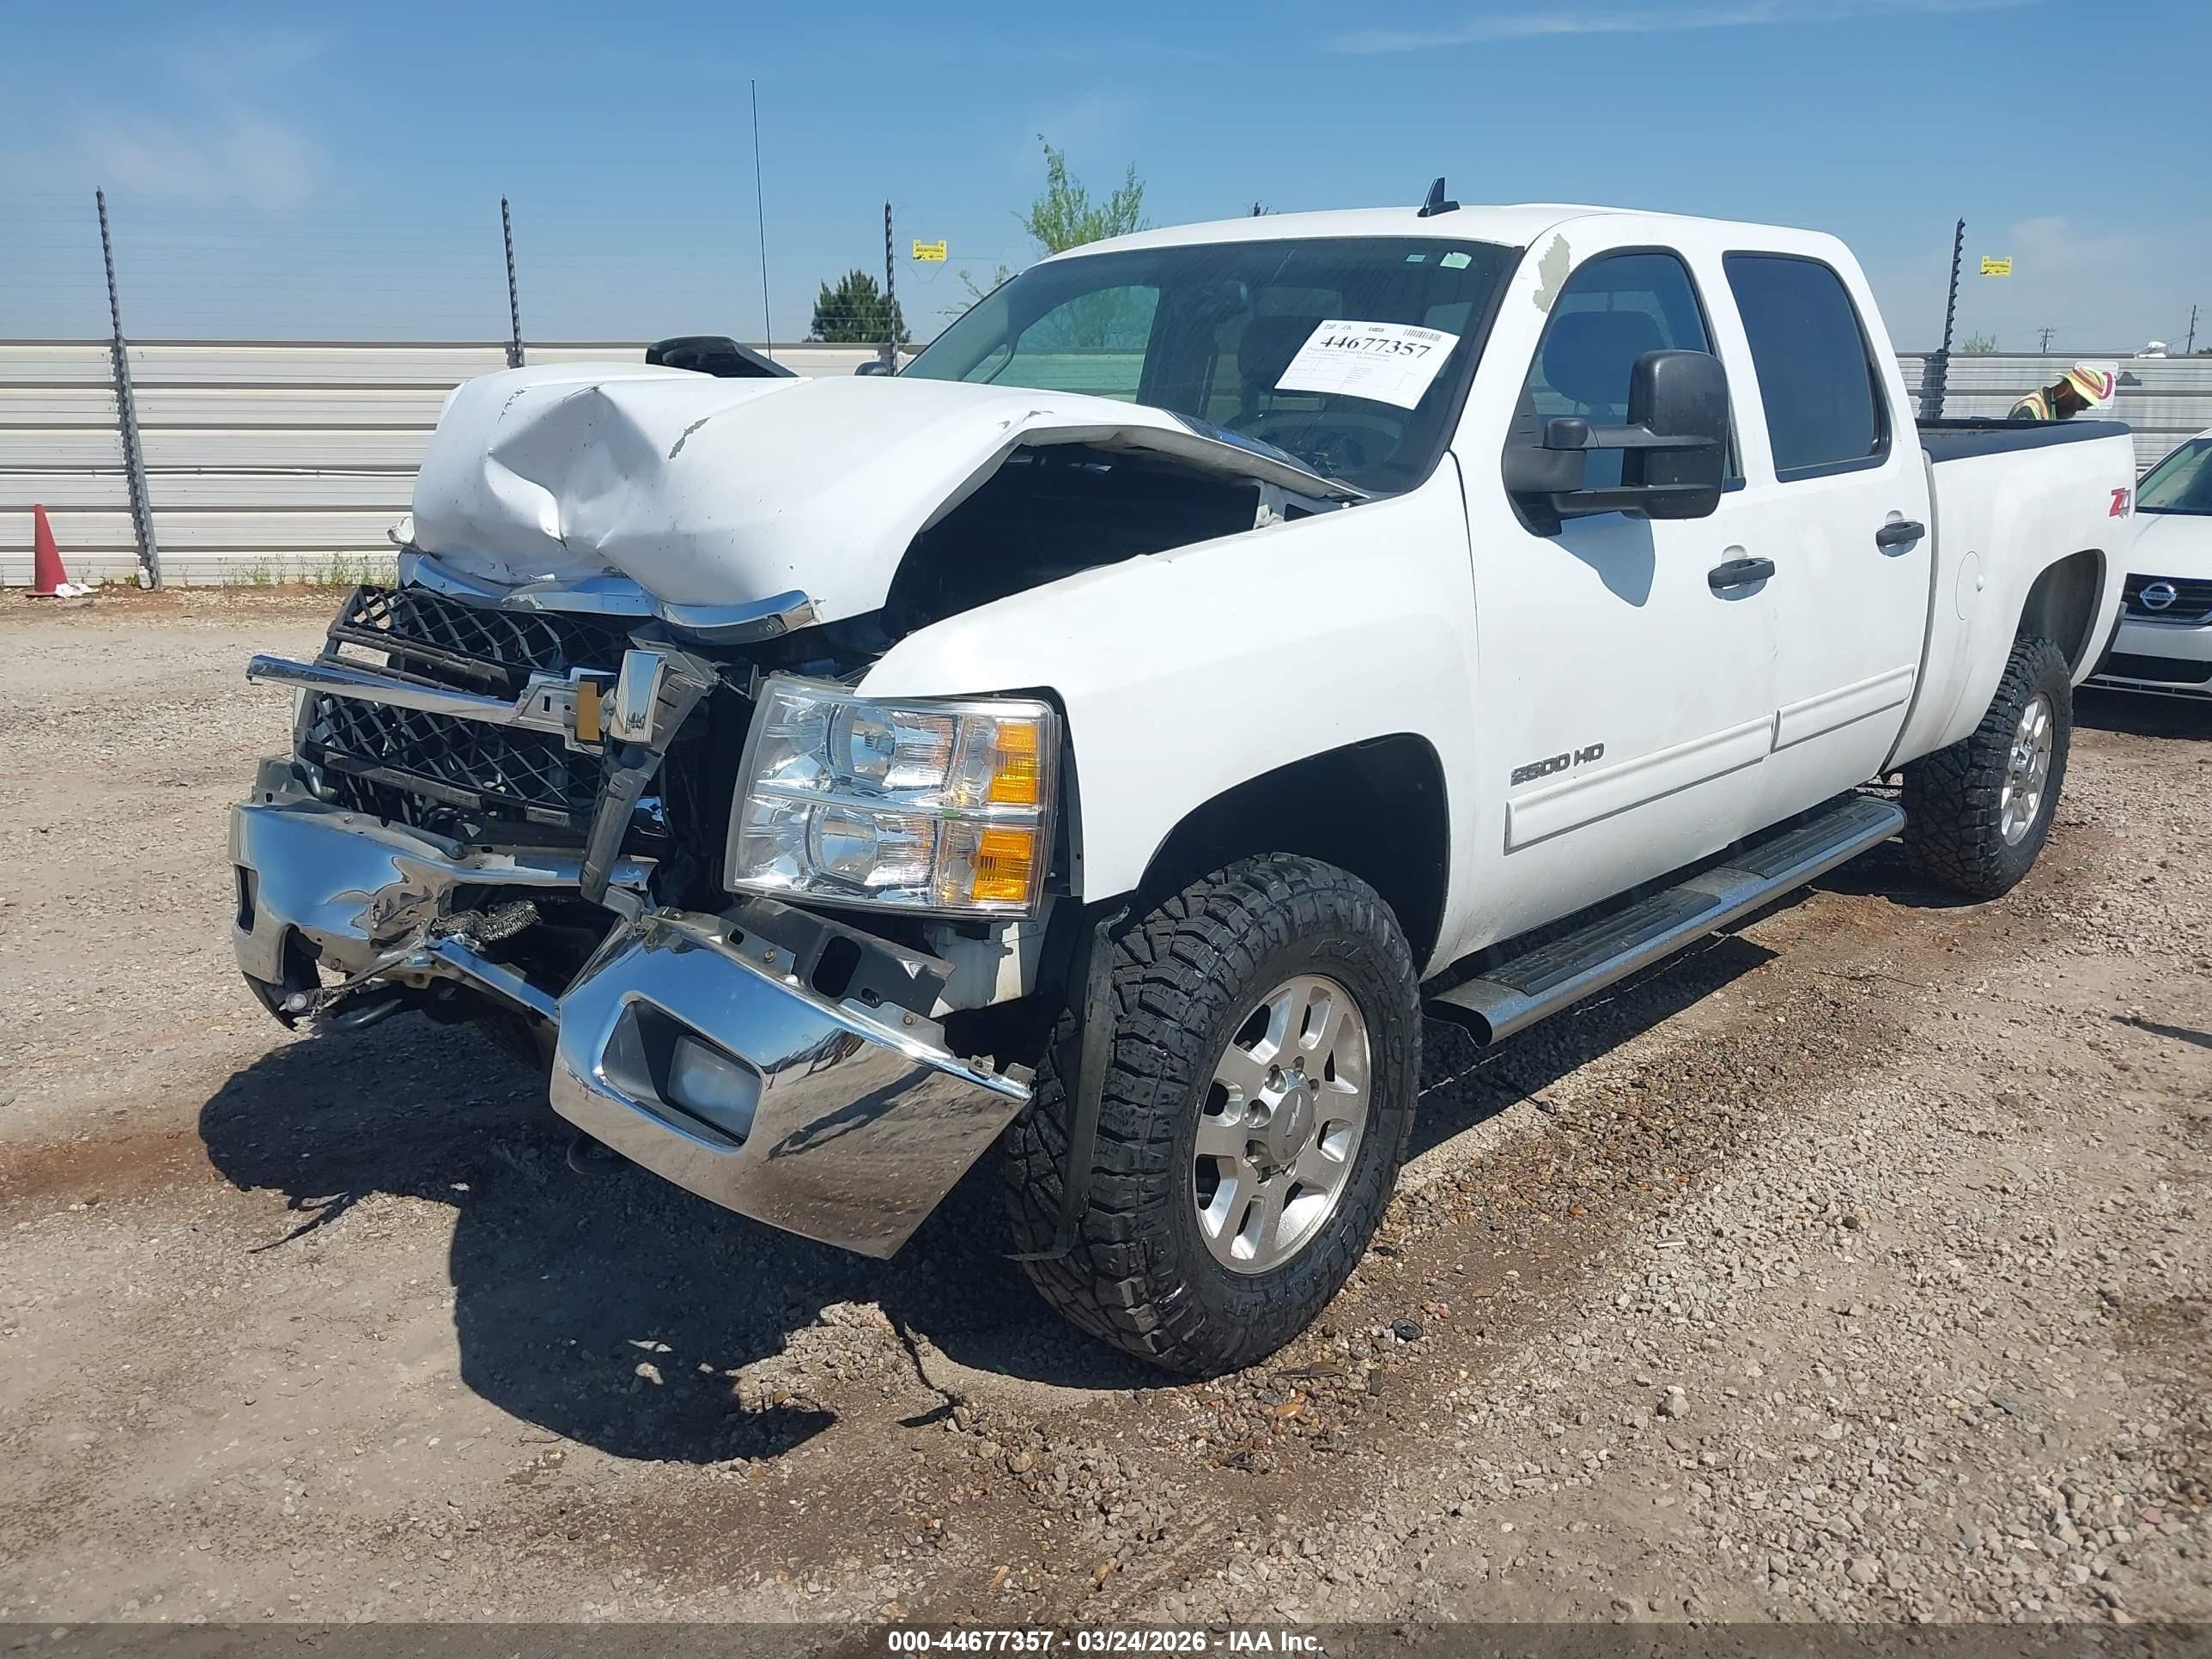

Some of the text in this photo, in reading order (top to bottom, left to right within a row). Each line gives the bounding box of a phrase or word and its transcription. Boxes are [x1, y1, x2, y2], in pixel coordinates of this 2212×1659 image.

[1321, 335, 1431, 359] 44677357
[1510, 742, 1604, 787] 2500 HD
